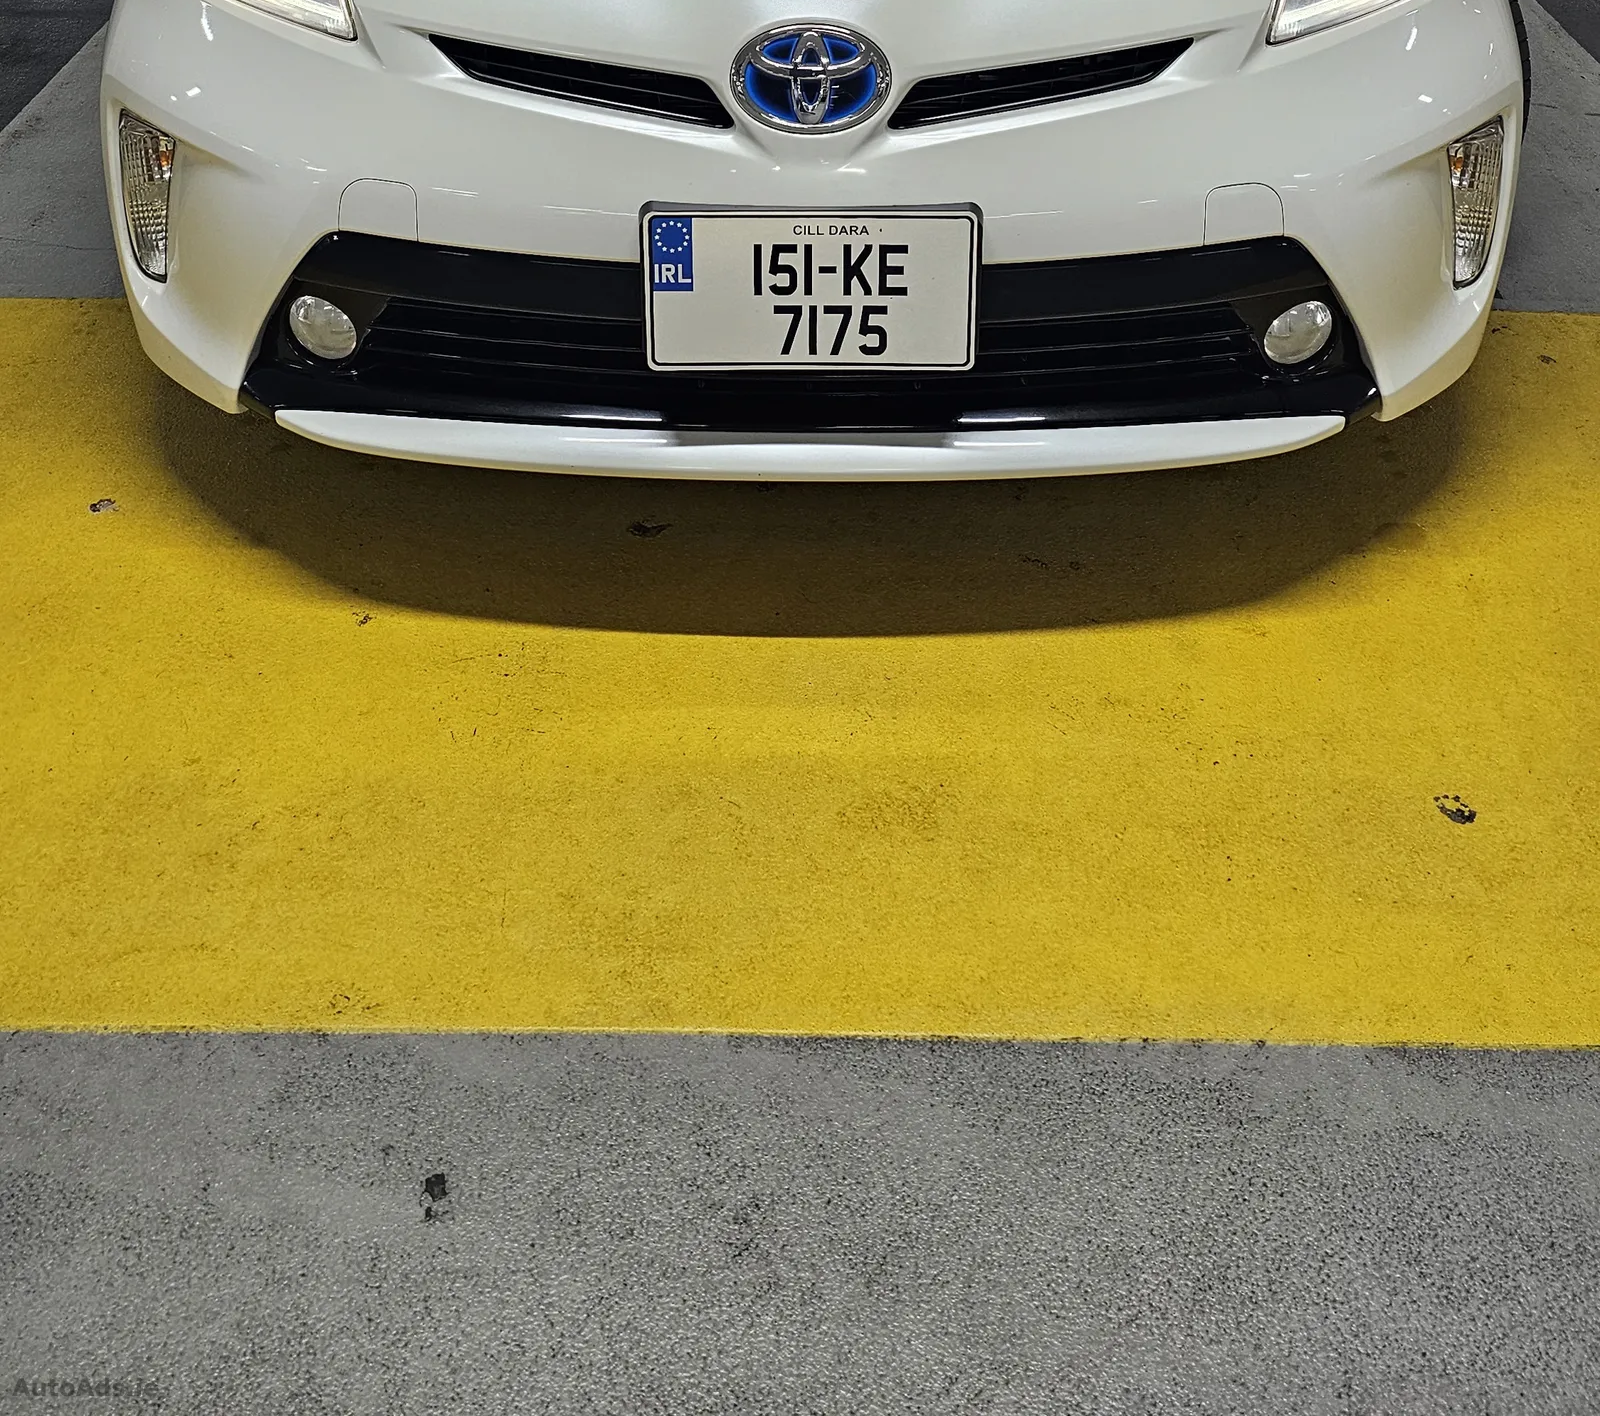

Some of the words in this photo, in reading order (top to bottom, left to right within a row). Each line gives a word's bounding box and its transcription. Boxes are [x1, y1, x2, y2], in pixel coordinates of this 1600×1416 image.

[792, 225, 825, 236] CILL
[828, 225, 870, 236] DARA
[653, 263, 692, 284] IRL
[753, 243, 909, 296] 151-KE
[773, 305, 889, 356] 7175
